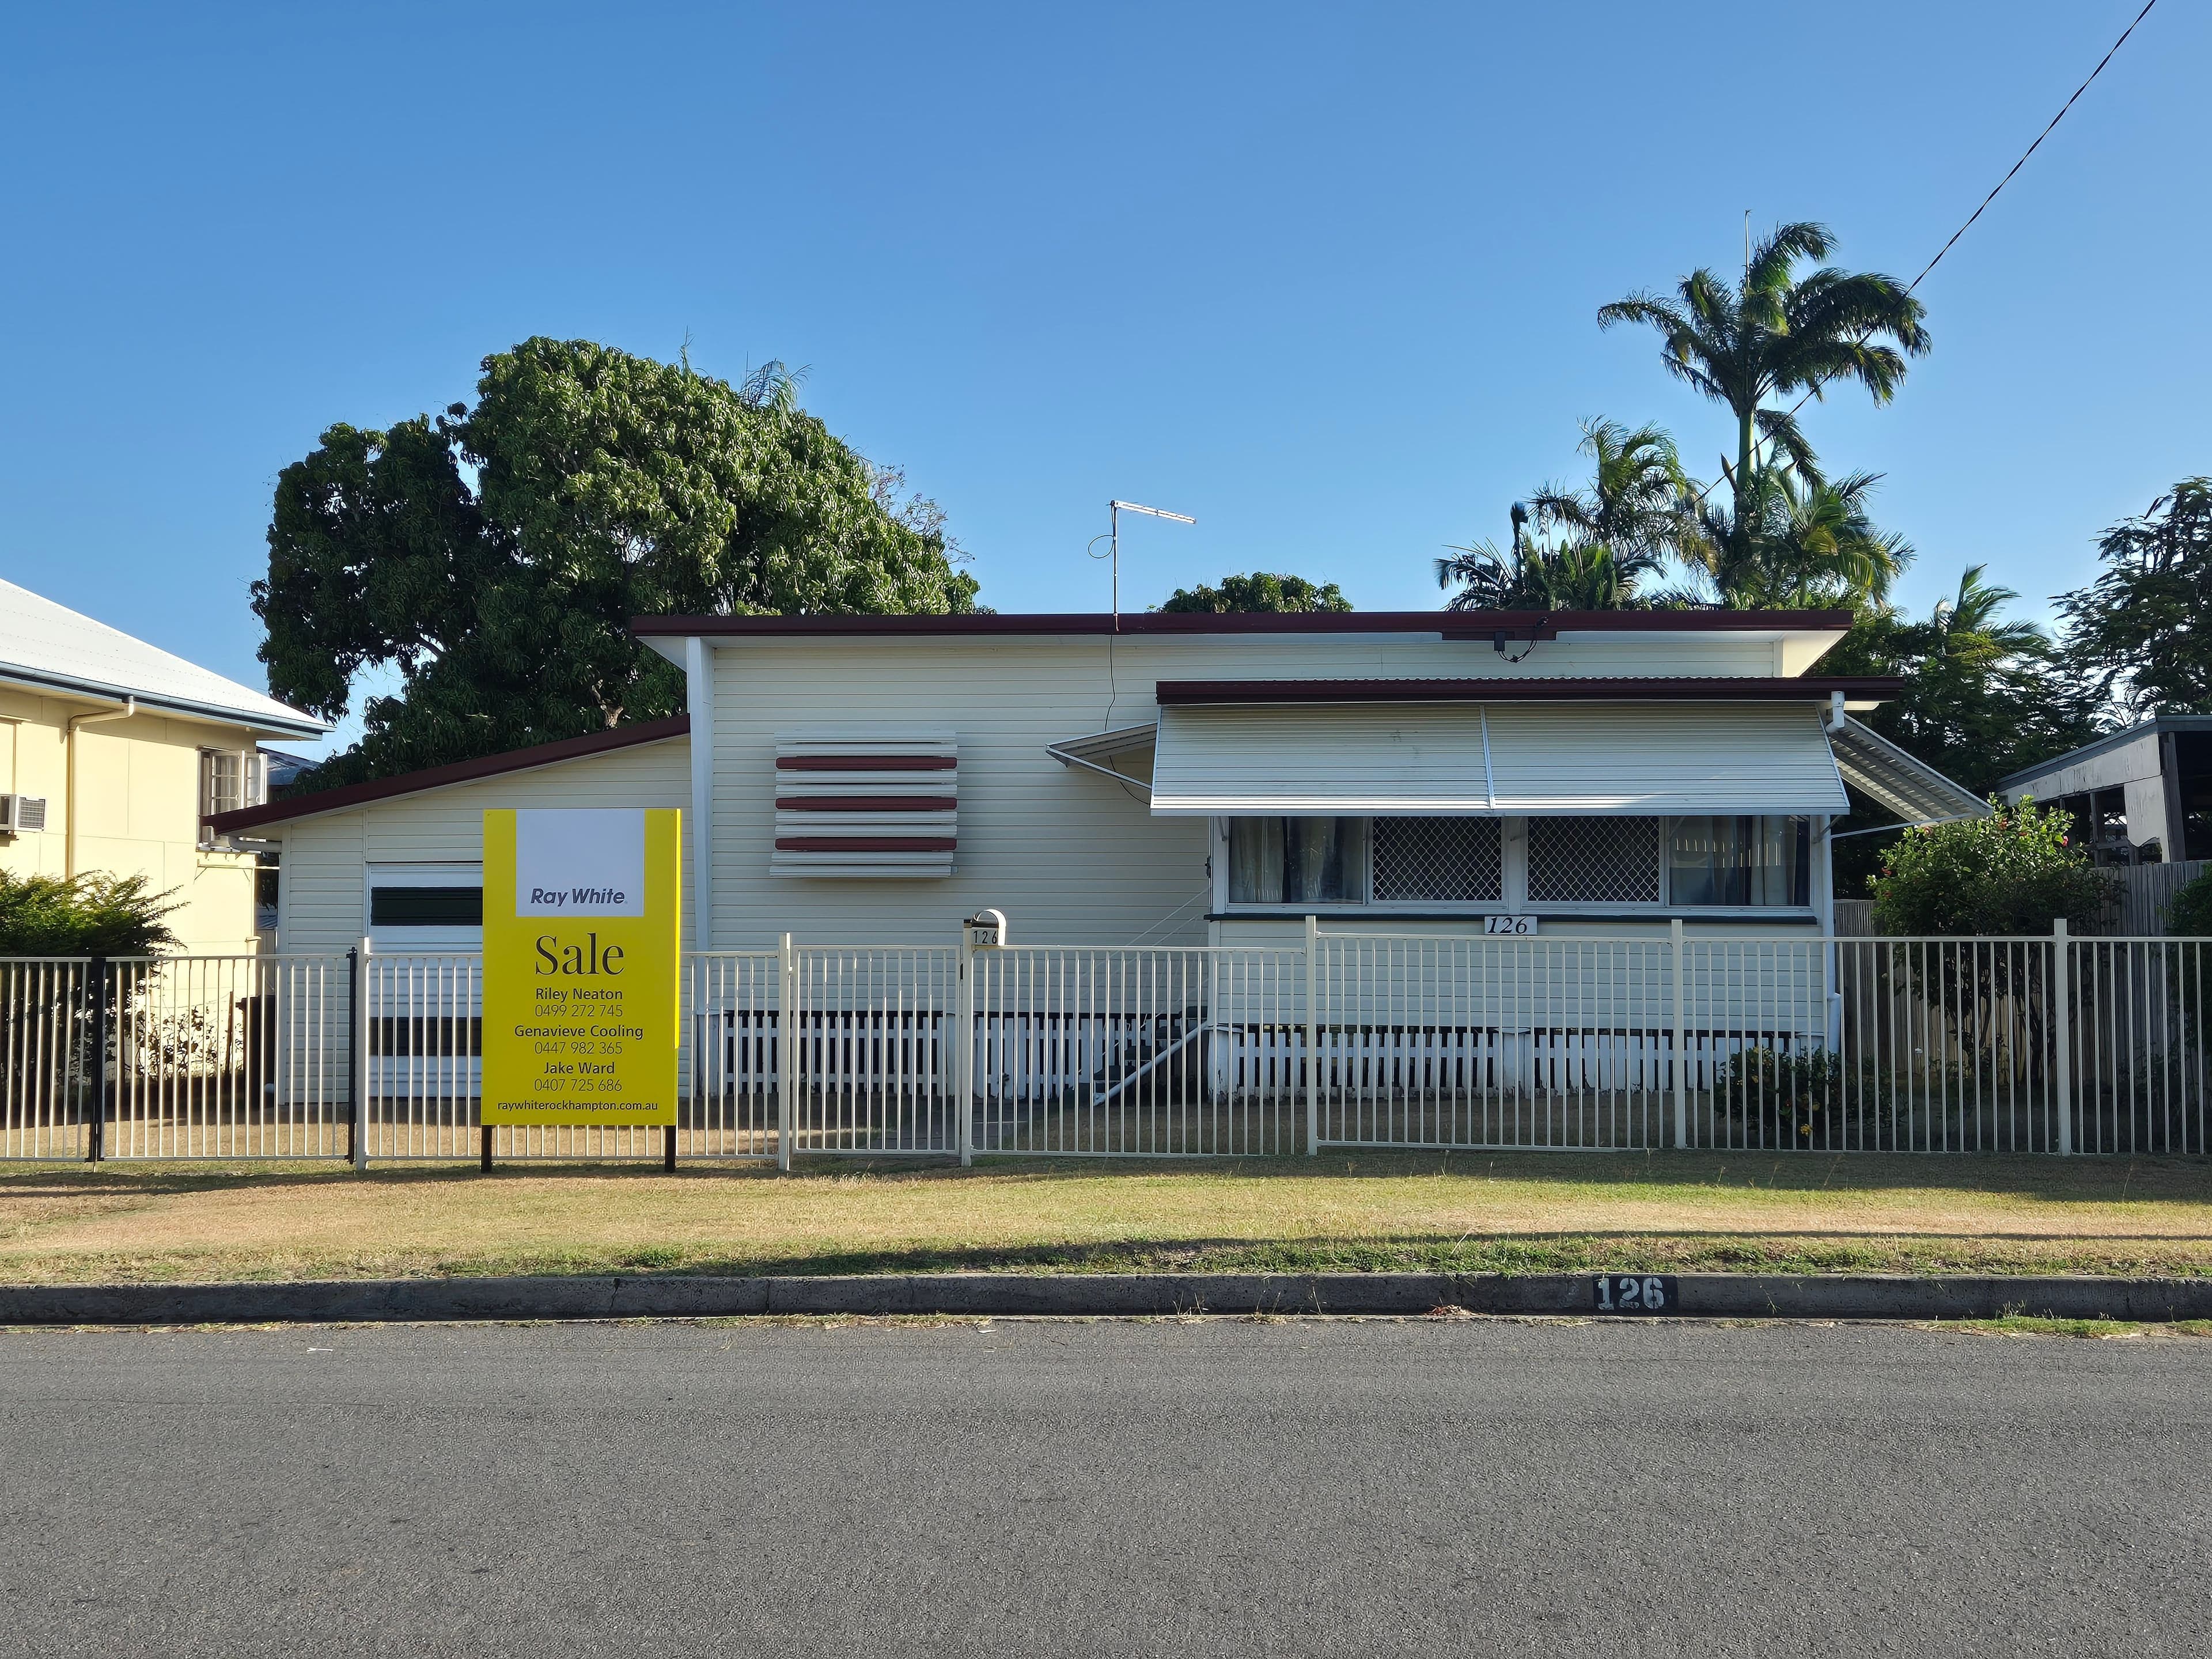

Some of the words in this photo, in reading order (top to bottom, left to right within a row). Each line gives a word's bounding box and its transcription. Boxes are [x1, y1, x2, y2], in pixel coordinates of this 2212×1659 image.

[531, 888, 569, 907] Ray
[572, 888, 625, 904] White
[1488, 916, 1527, 934] 126
[974, 930, 997, 944] 126
[535, 931, 624, 975] Sale
[536, 987, 568, 1003] Riley
[573, 988, 623, 1000] Neaton
[535, 1005, 567, 1017] 0499
[571, 1005, 594, 1017] 272
[599, 1005, 623, 1017] 745
[514, 1025, 585, 1037] Genavieve
[590, 1025, 643, 1040] Cooling
[535, 1041, 566, 1054] 0447
[571, 1041, 594, 1054] 982
[599, 1041, 622, 1054] 365
[544, 1062, 574, 1074] Jake
[578, 1062, 615, 1074] Ward
[535, 1079, 566, 1091] 0407
[571, 1079, 594, 1091] 725
[599, 1079, 622, 1091] 686
[498, 1100, 658, 1112] raywhiterockhampton.com.au
[1597, 1277, 1664, 1310] 126
